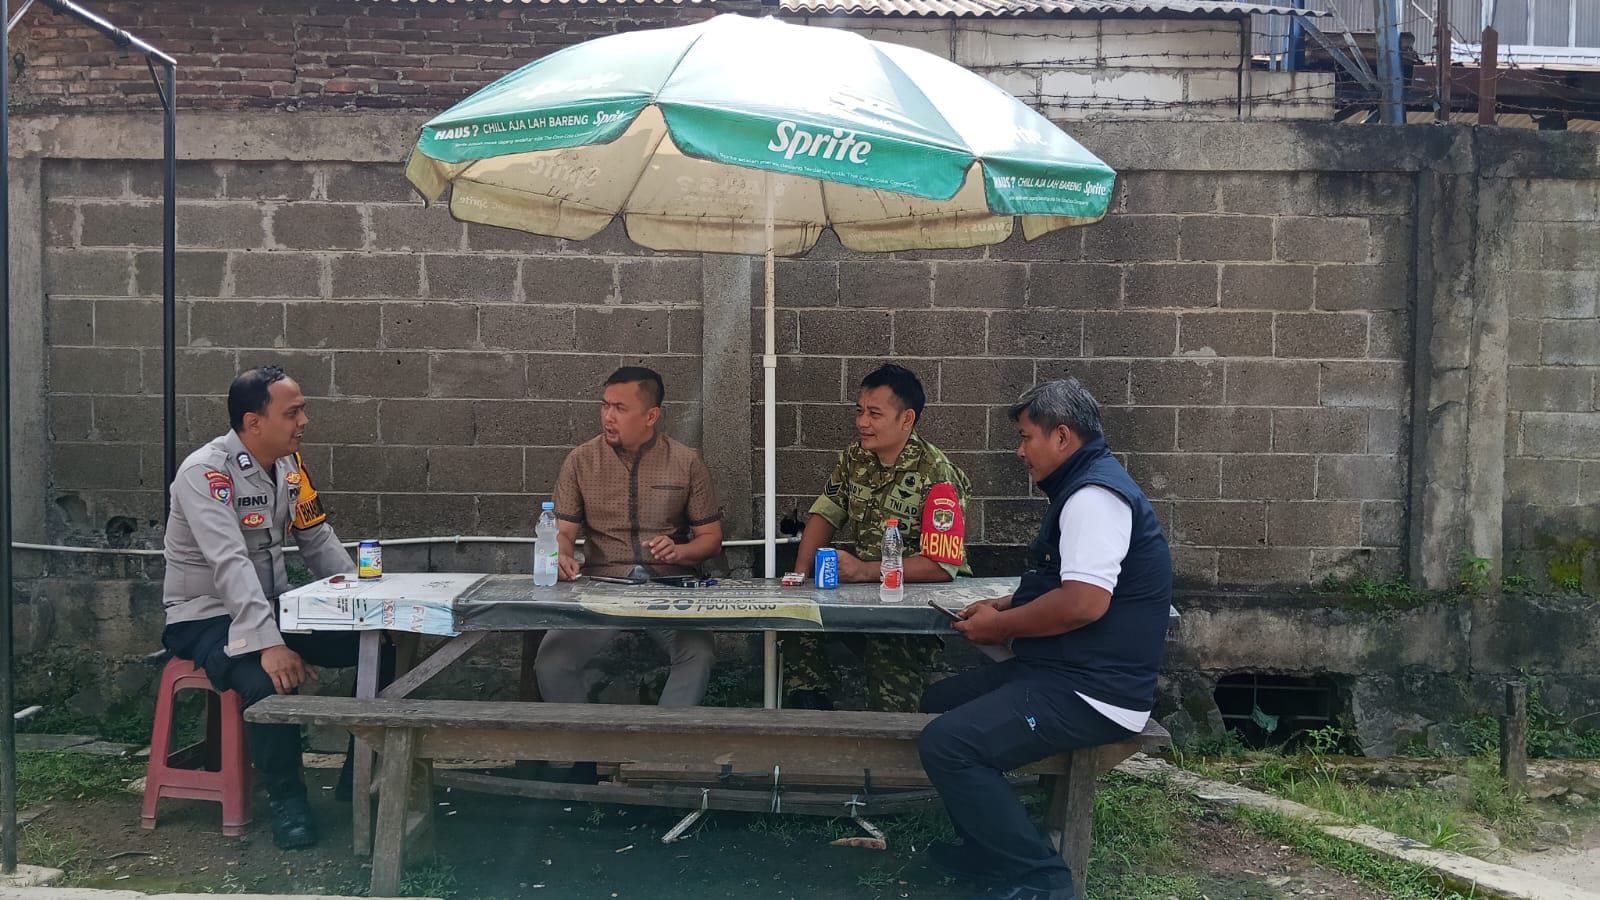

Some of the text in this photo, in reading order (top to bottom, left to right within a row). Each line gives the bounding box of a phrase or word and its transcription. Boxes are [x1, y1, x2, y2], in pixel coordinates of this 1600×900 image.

[483, 122, 507, 134] CHILL
[509, 120, 526, 131] AJA
[528, 118, 546, 129] LAH
[549, 115, 588, 127] BARENG
[768, 121, 871, 164] Sprite
[1083, 181, 1107, 196] Sprite
[237, 495, 268, 507] IBNU
[890, 499, 918, 515] TNI AD
